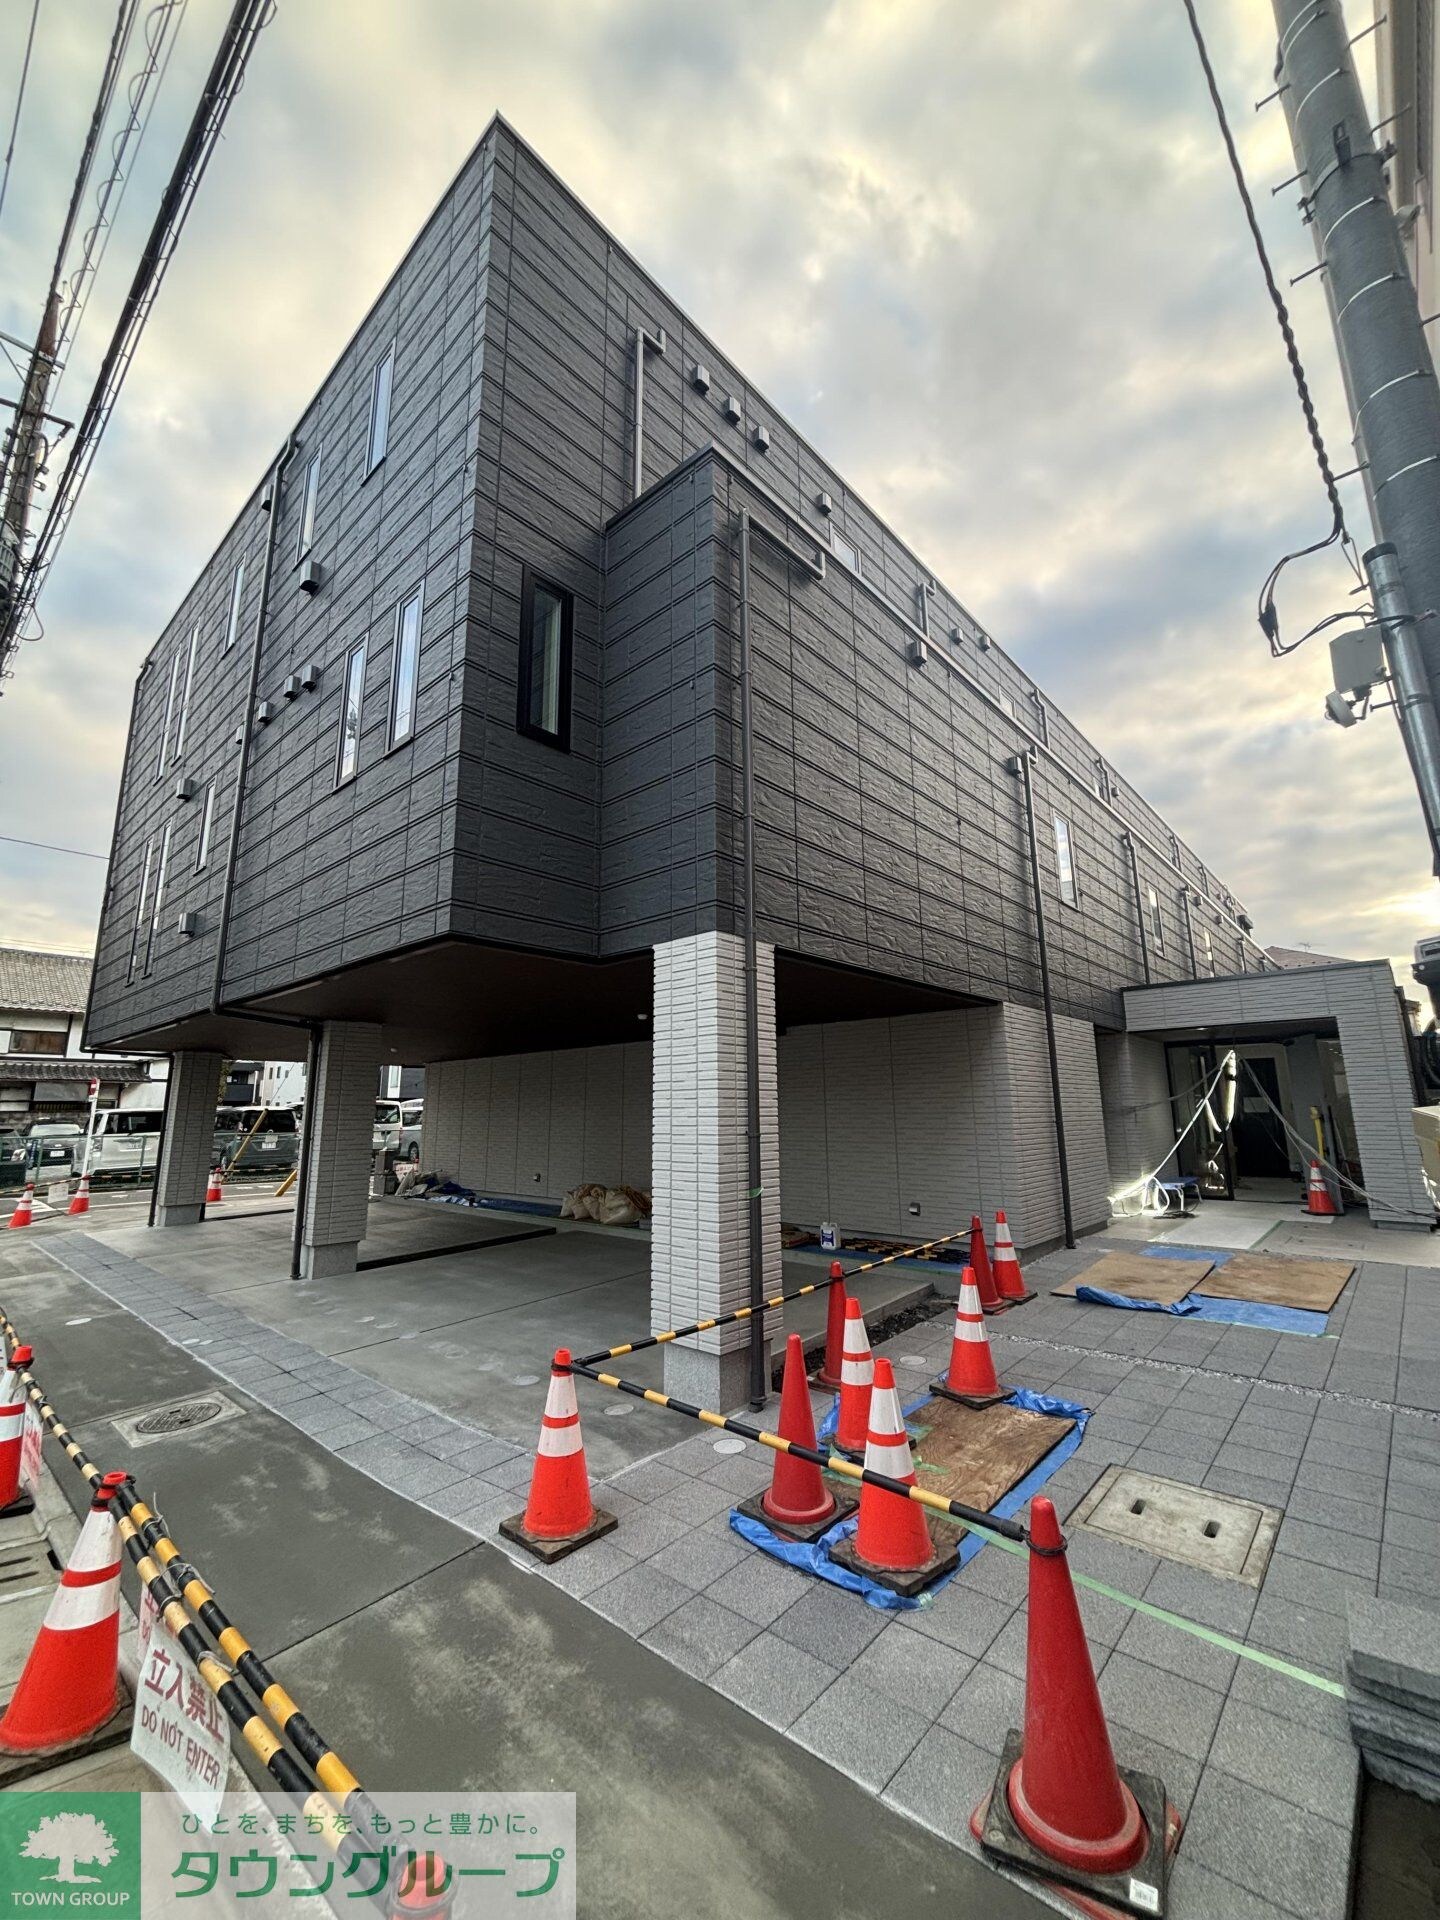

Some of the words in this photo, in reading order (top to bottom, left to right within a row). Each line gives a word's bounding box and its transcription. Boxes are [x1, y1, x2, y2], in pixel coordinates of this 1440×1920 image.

[144, 1649, 224, 1743] 立入禁止
[141, 1704, 157, 1733] DO
[160, 1718, 183, 1754] NOT
[185, 1739, 221, 1790] ENTER
